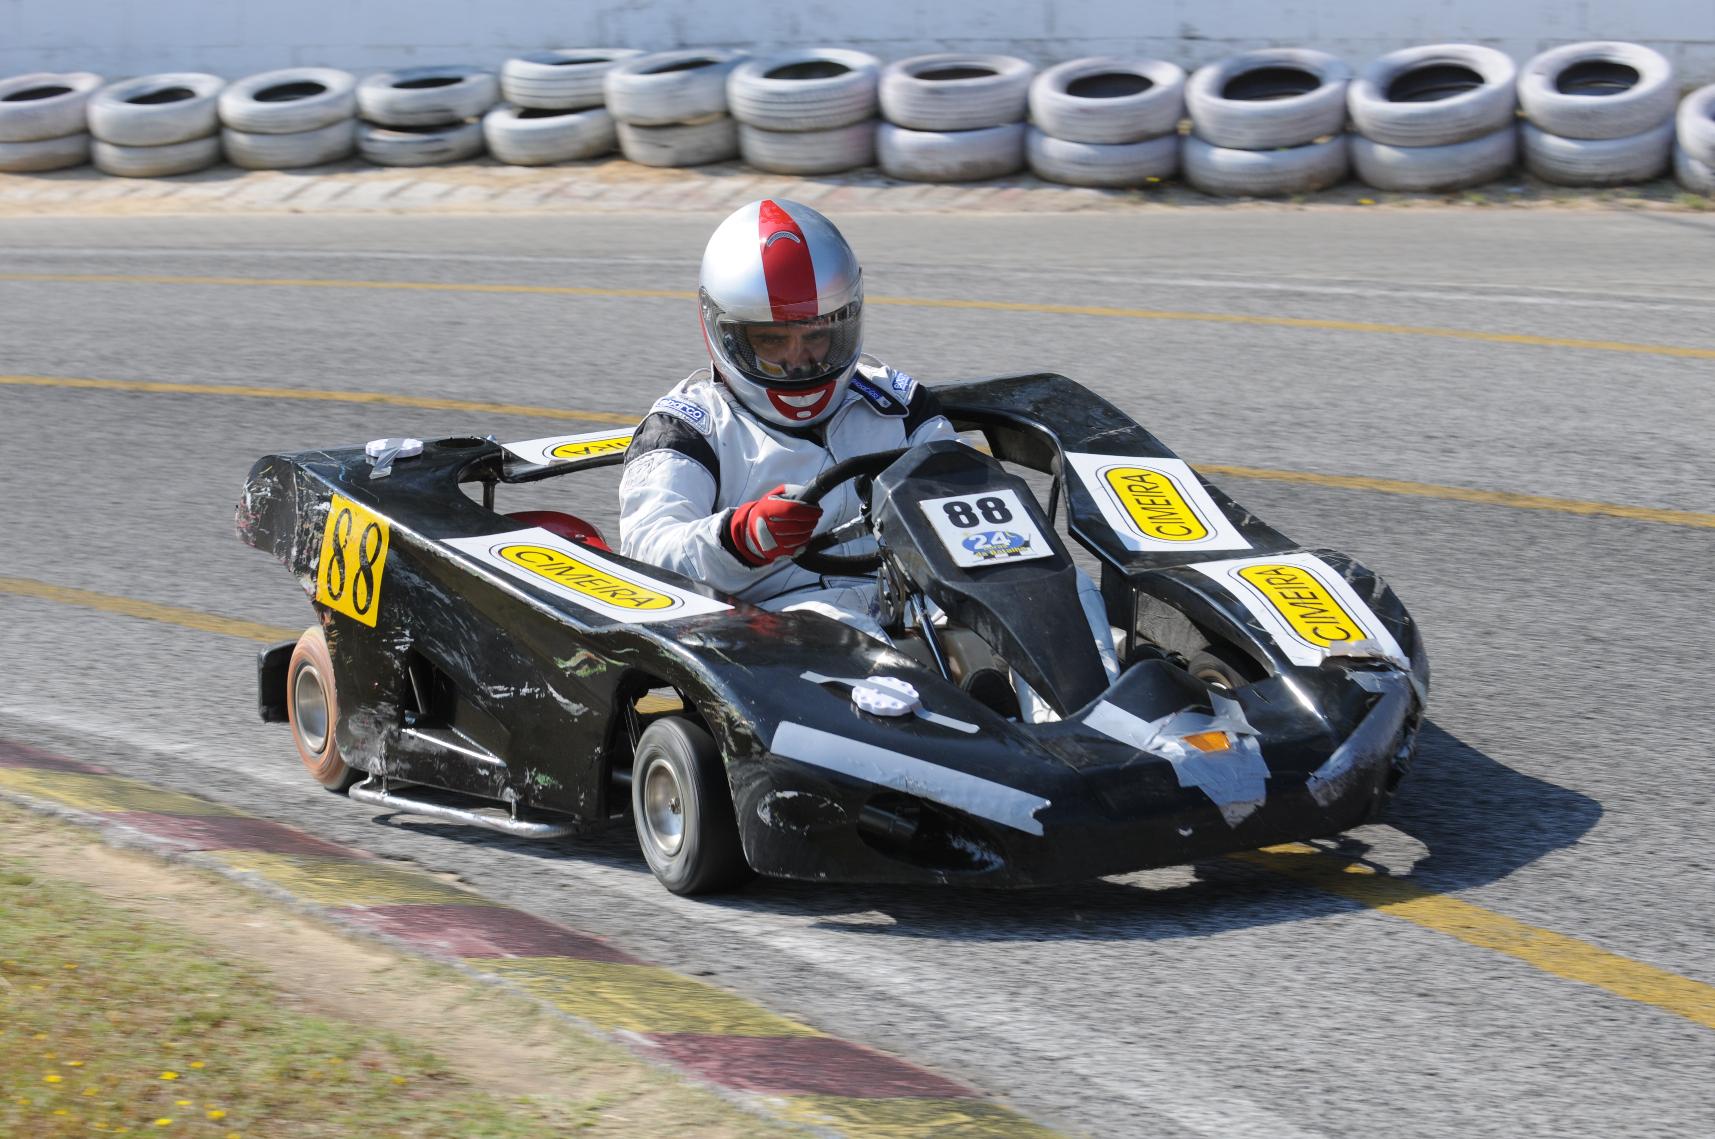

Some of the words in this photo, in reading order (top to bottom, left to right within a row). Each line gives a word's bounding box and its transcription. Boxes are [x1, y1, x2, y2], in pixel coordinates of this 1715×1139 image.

[658, 398, 702, 419] parco
[942, 496, 1013, 528] 88
[1120, 473, 1192, 536] CIMEIRA
[327, 508, 382, 615] 88
[969, 531, 1011, 550] 24
[515, 550, 656, 607] CIMEIRA
[1254, 567, 1351, 641] CIMEIRA
